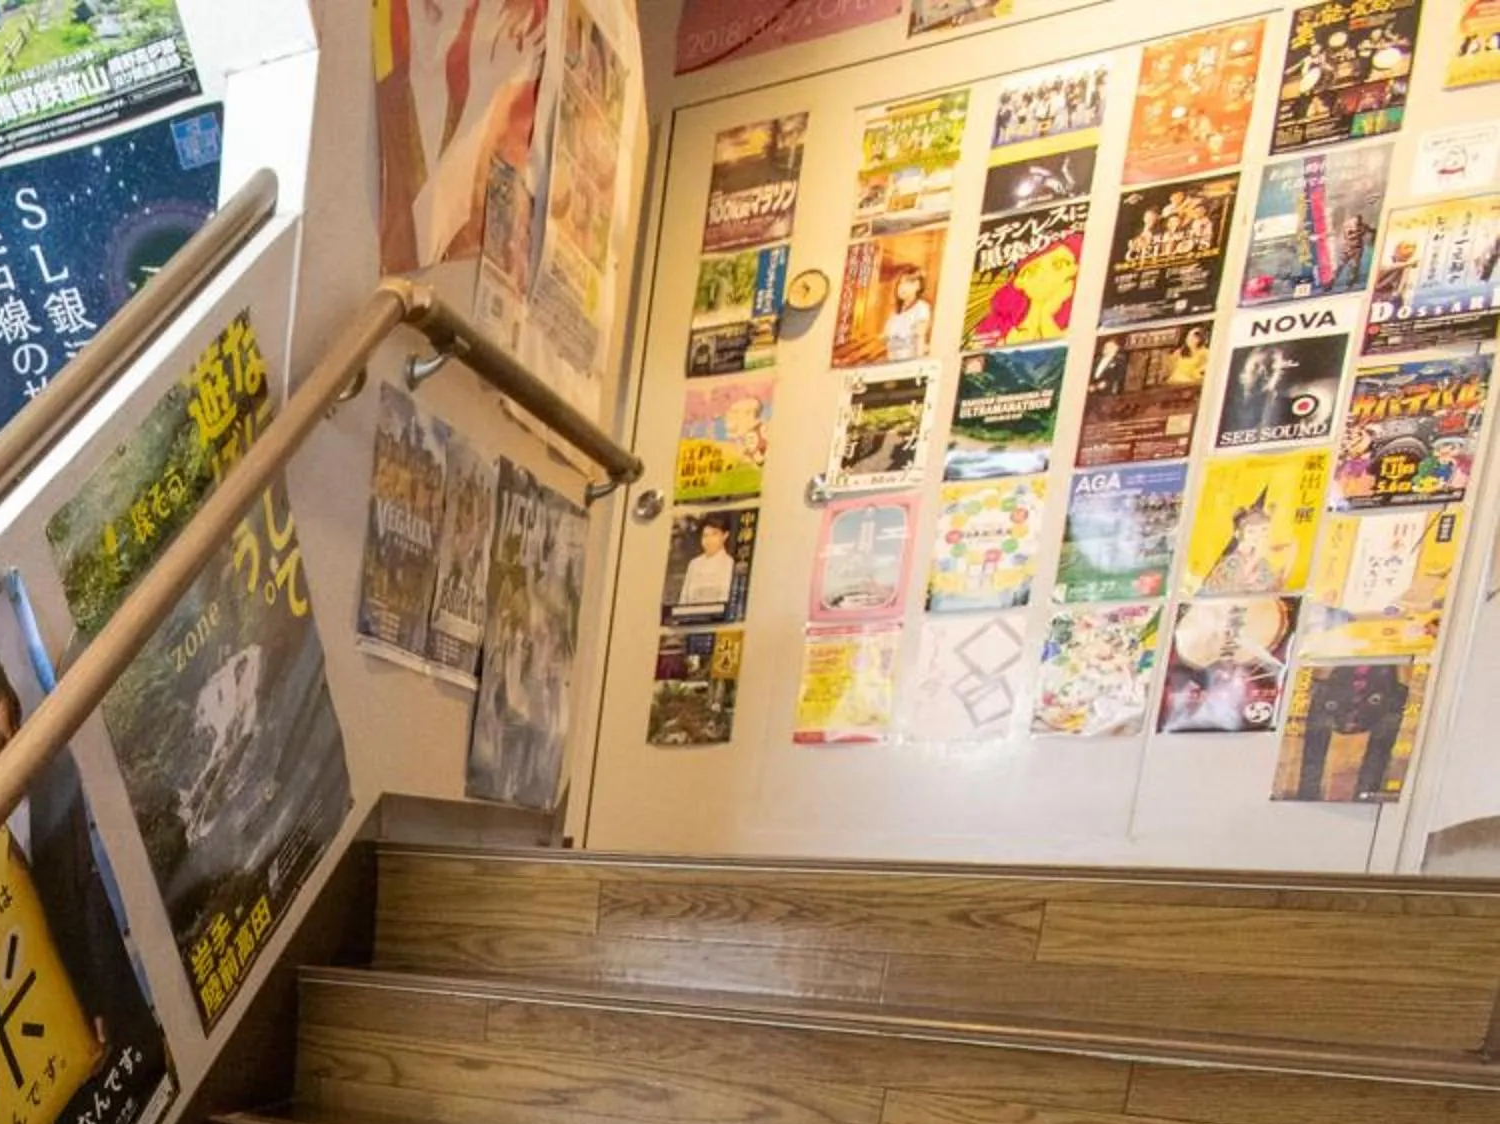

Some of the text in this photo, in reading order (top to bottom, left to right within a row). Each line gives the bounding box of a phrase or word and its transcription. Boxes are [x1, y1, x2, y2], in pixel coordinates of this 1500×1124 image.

[1250, 309, 1338, 338] NOVA
[1218, 421, 1329, 446] SEE SOUND
[1076, 471, 1122, 494] AGA
[169, 602, 222, 674] zone
